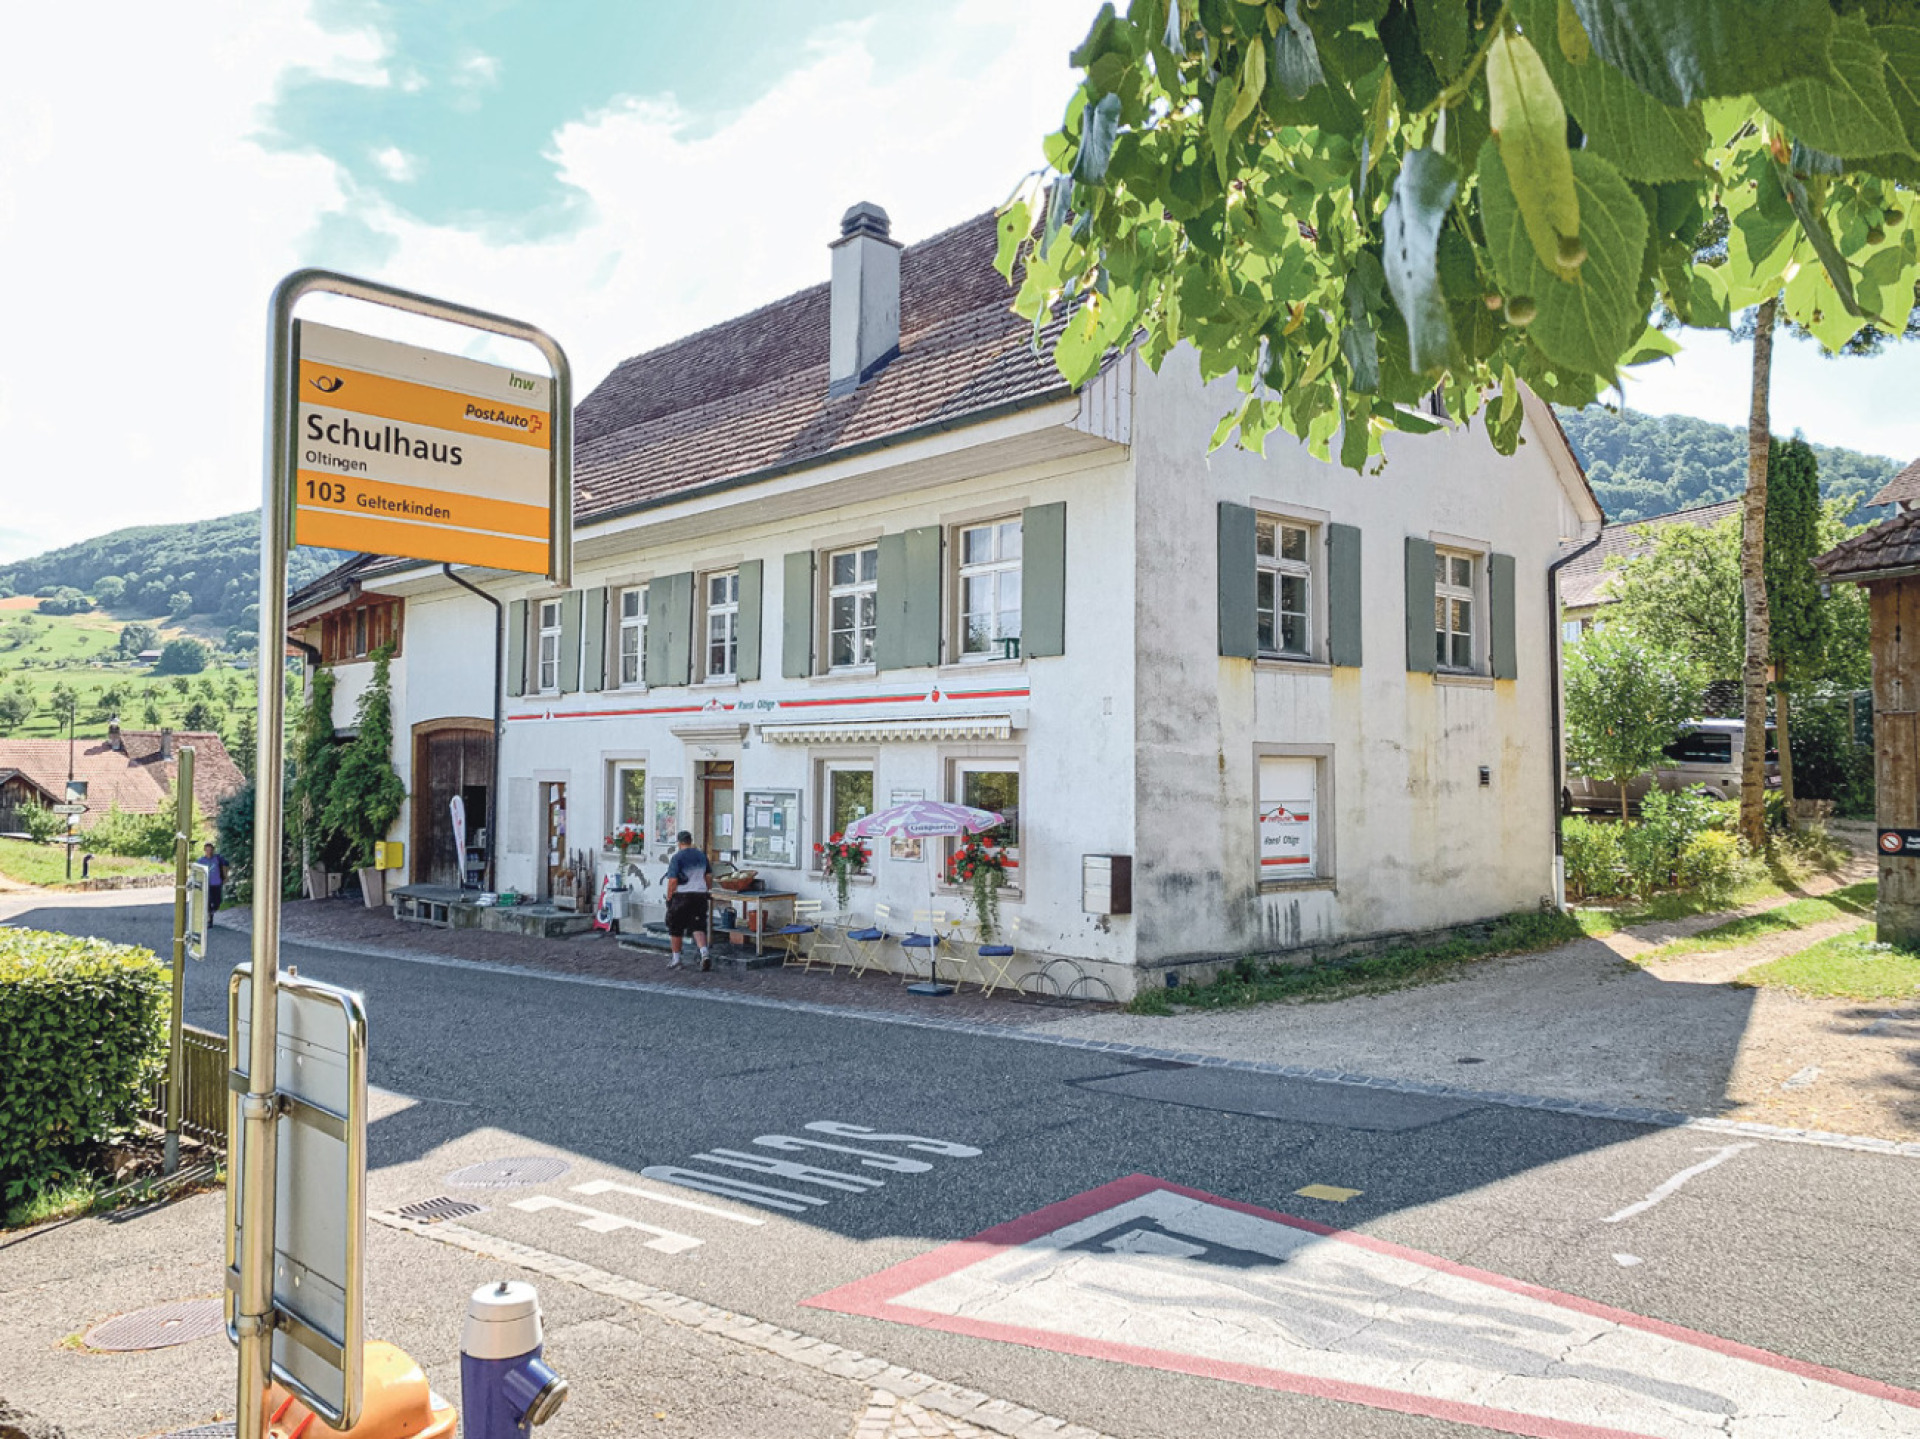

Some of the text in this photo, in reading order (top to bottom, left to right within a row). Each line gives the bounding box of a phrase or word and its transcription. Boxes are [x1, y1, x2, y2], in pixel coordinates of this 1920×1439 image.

[465, 403, 528, 428] PostAuto
[307, 413, 463, 466] Schulhaus
[305, 450, 368, 472] Oltingen
[306, 479, 451, 519] 103 Gelterkinden
[507, 1119, 983, 1256] SCHULE
